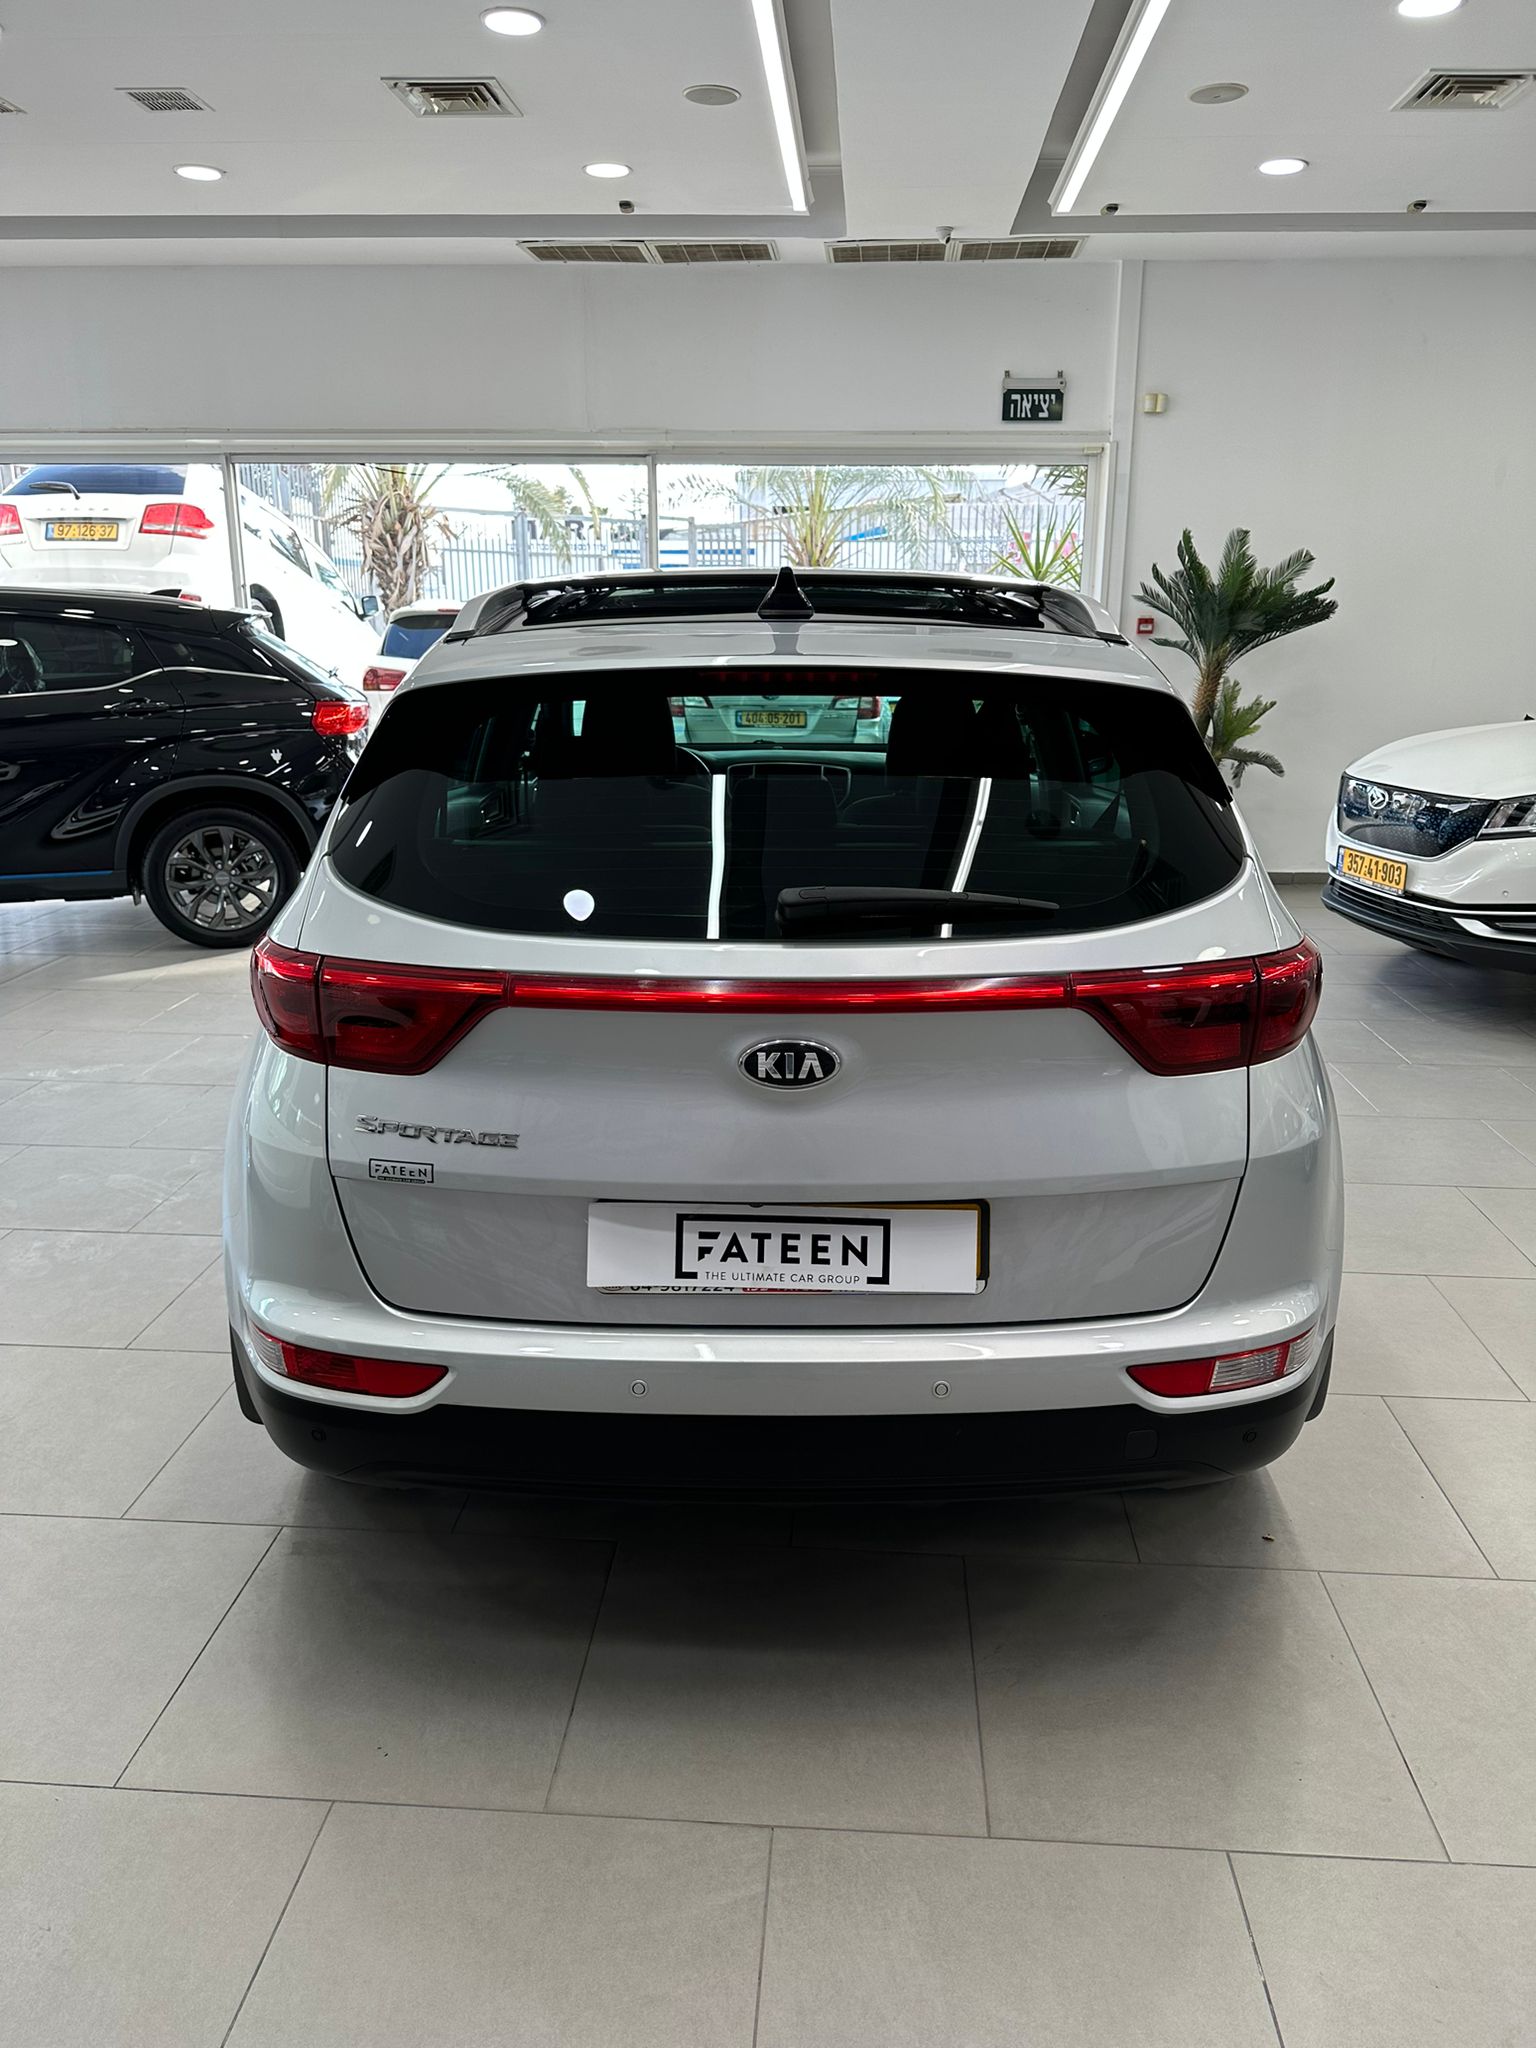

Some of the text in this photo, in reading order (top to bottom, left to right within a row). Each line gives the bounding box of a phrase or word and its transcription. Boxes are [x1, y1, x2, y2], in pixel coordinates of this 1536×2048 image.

[1010, 393, 1056, 418] יציאה
[756, 1052, 824, 1079] KIA
[354, 1114, 521, 1149] SPORTAGE
[697, 1231, 869, 1267] FATEEN
[705, 1271, 861, 1285] THE ULTIMATE CAR GROUP
